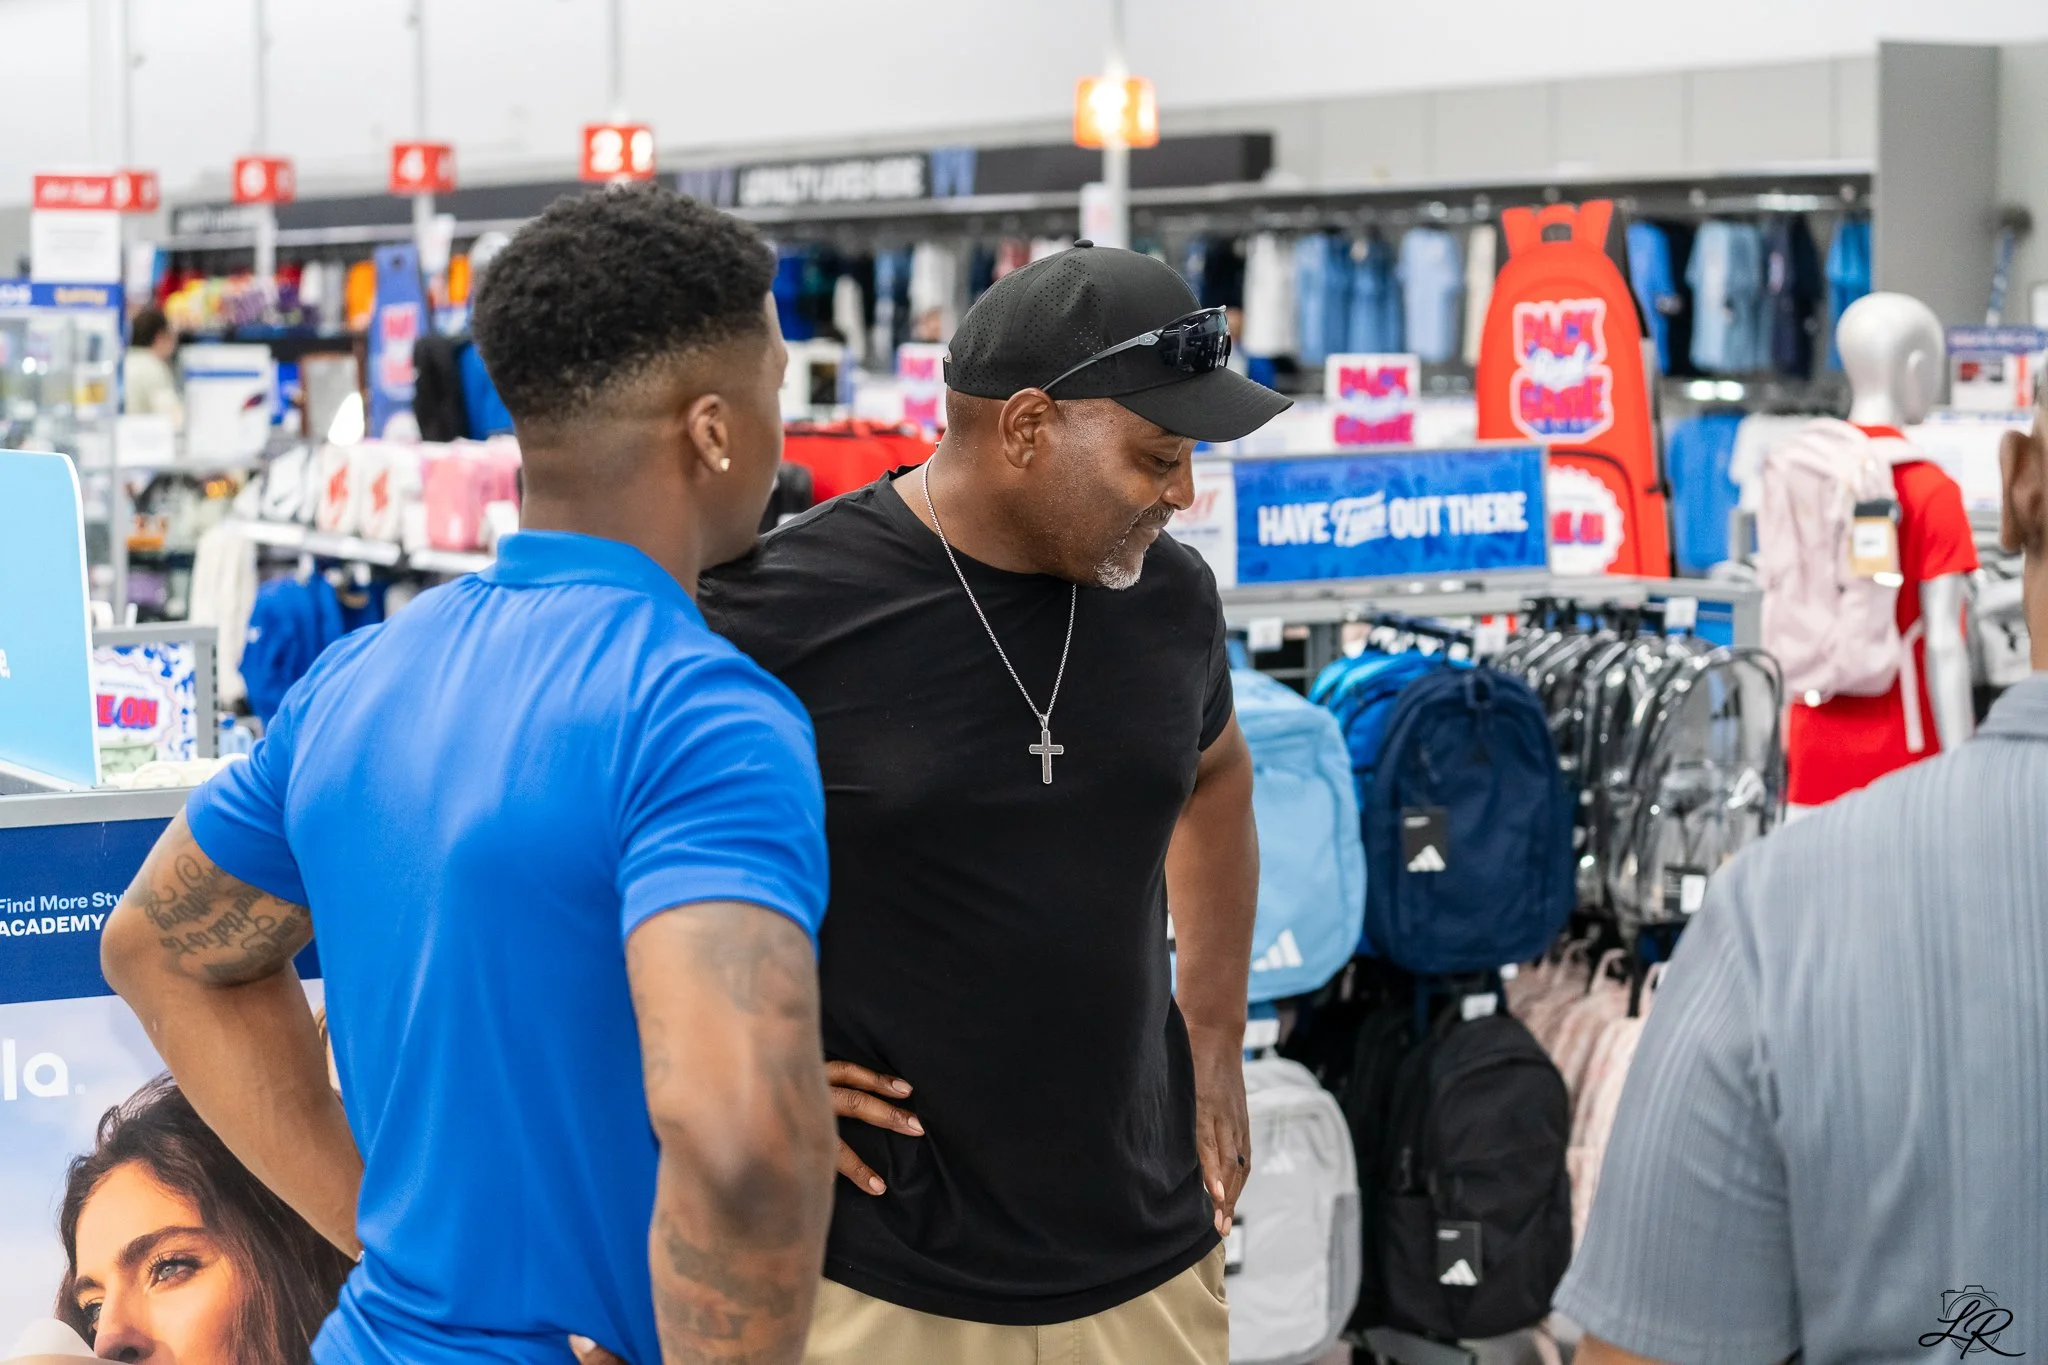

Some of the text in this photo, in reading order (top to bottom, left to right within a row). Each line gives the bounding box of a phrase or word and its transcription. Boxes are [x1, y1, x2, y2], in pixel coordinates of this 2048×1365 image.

[1258, 502, 1330, 546] HAVE
[1390, 495, 1442, 539] OUT
[1447, 491, 1528, 534] THERE
[117, 696, 159, 729] ON
[40, 894, 89, 912] More
[0, 913, 105, 937] ACADEMY
